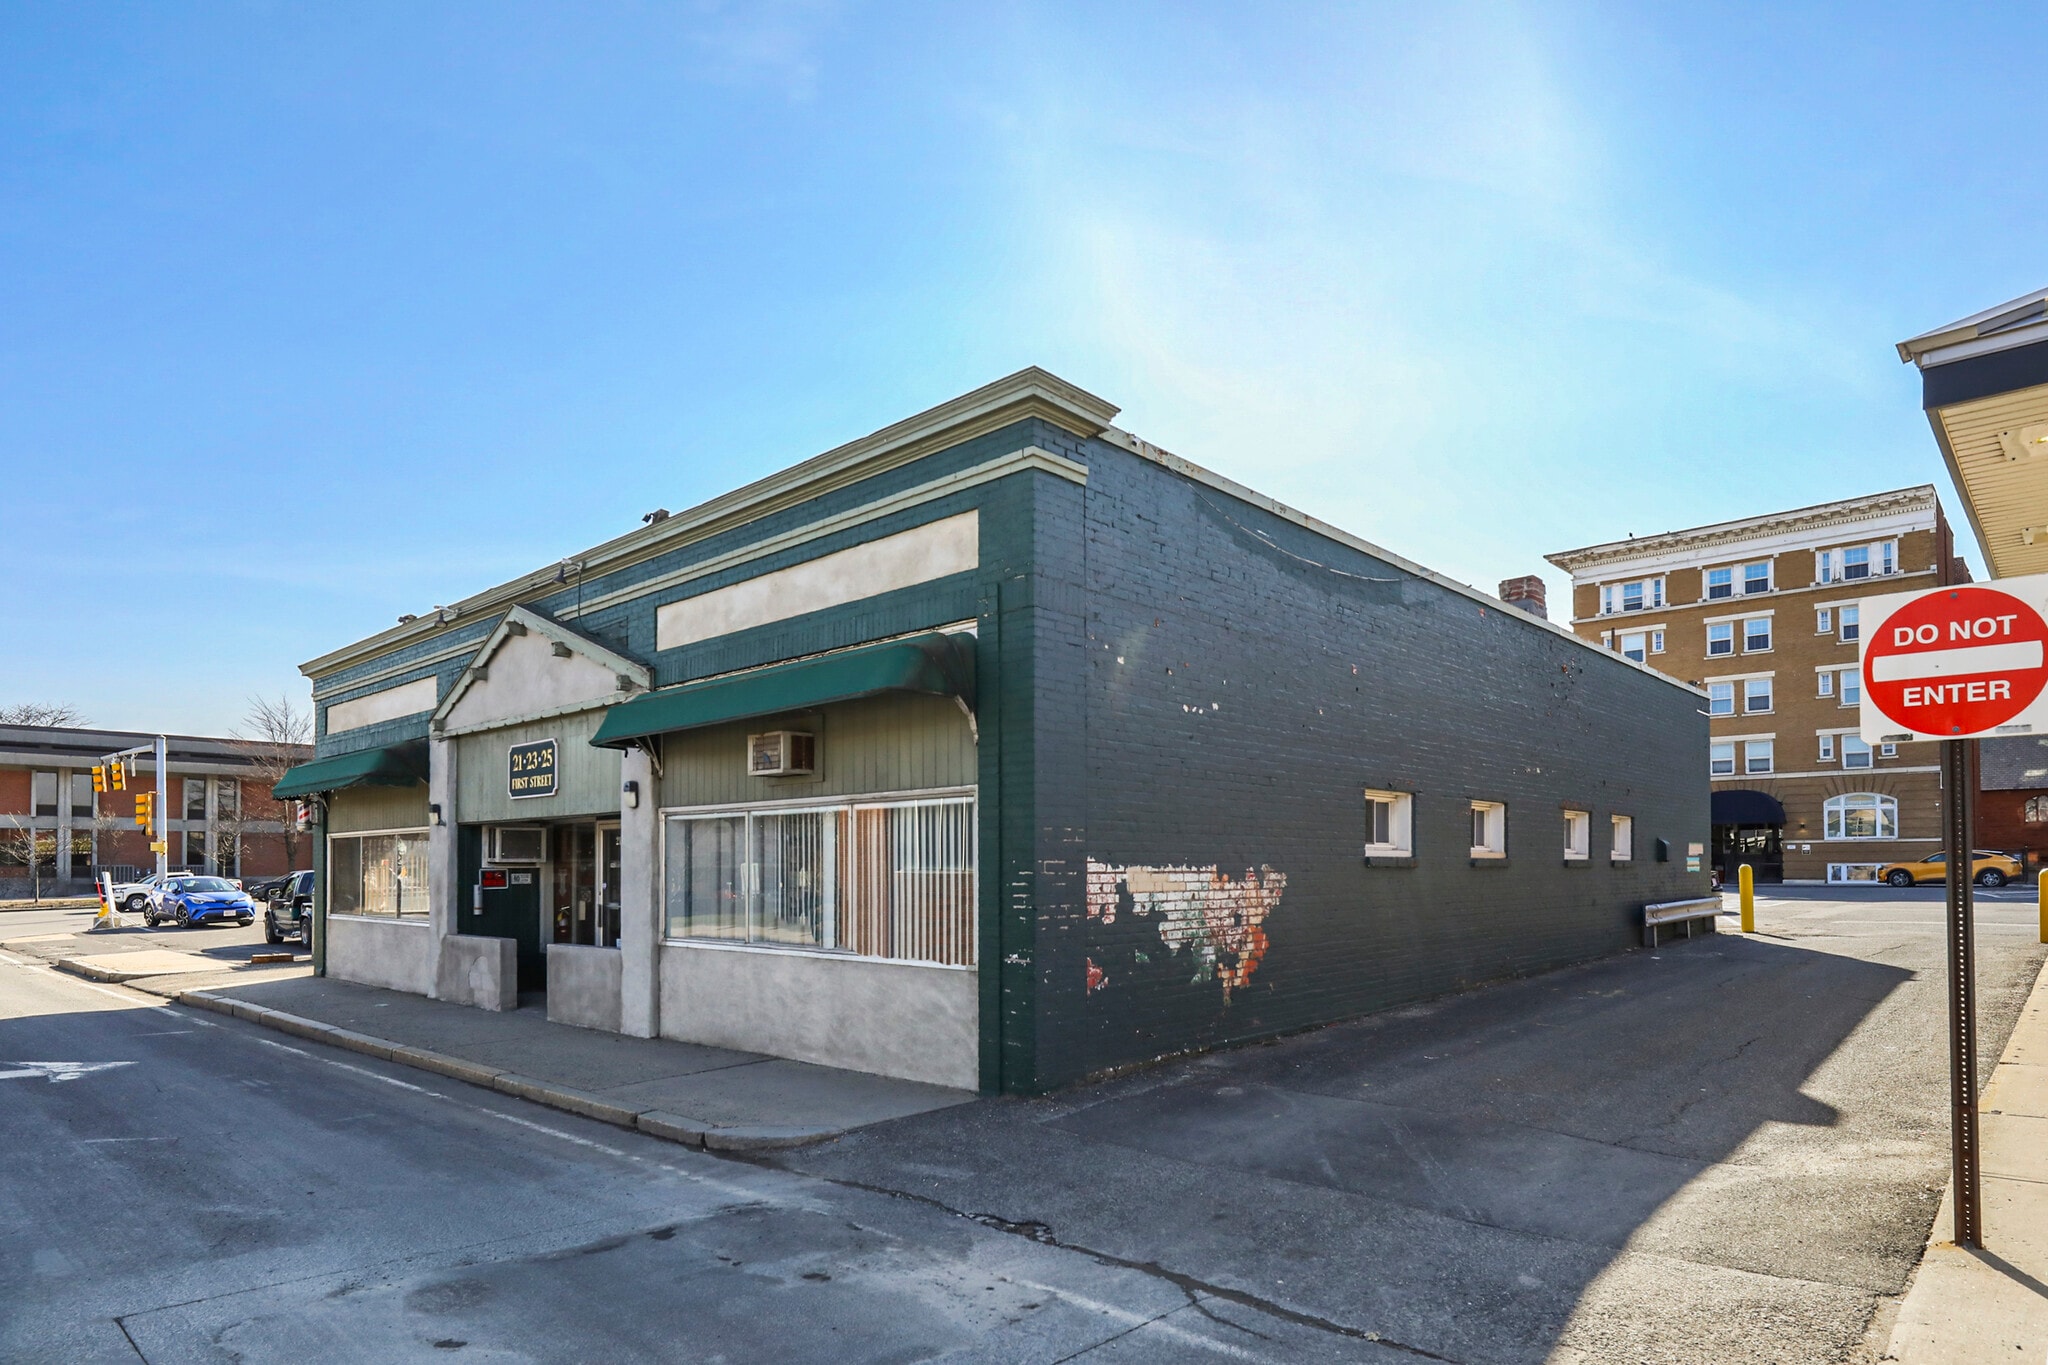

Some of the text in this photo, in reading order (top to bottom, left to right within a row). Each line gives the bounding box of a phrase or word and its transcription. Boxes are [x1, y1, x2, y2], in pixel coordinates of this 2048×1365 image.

[1894, 614, 2017, 647] DO NOT
[1903, 680, 2011, 707] ENTER
[511, 774, 553, 790] FIRST STREET
